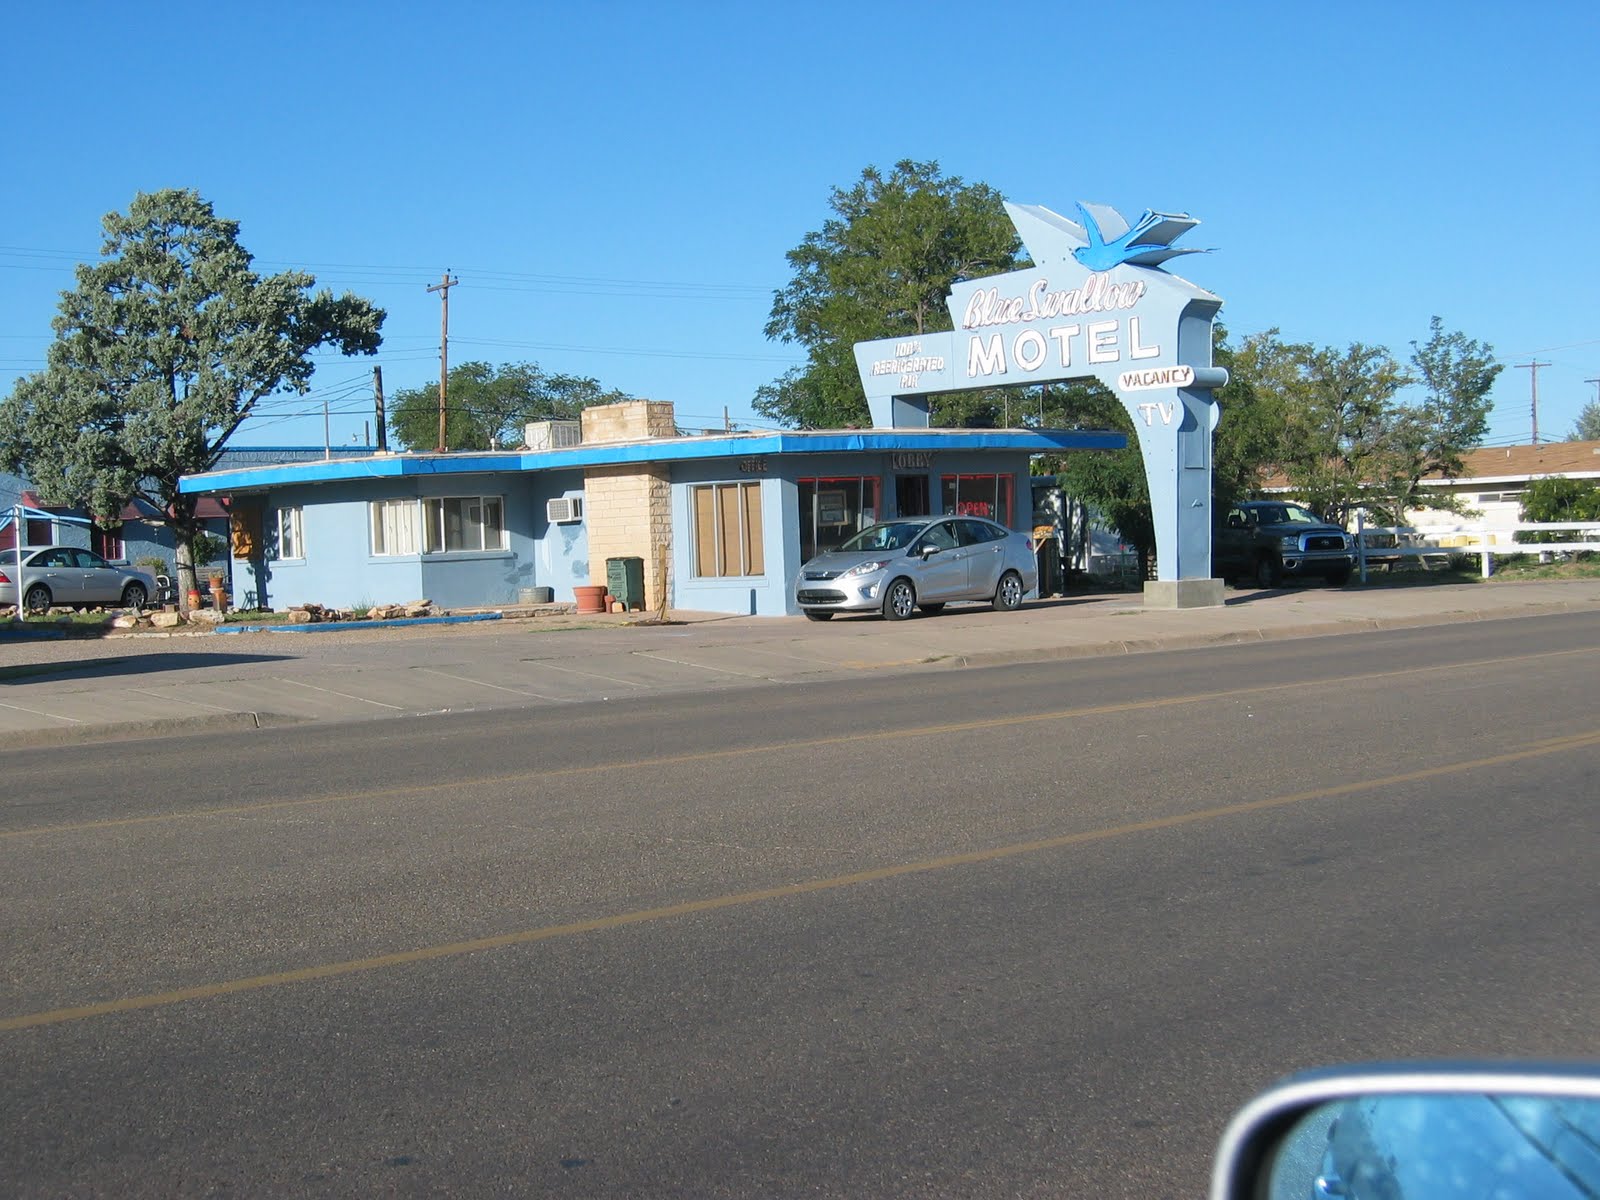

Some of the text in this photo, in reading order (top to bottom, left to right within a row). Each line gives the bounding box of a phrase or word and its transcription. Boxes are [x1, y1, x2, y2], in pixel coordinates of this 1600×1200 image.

[962, 272, 1147, 330] Blue Swallow
[967, 316, 1160, 378] MOTEL
[1123, 367, 1191, 387] VACANCY
[1137, 402, 1174, 426] TV
[891, 453, 932, 470] LOBBY
[958, 501, 989, 516] OPEN
